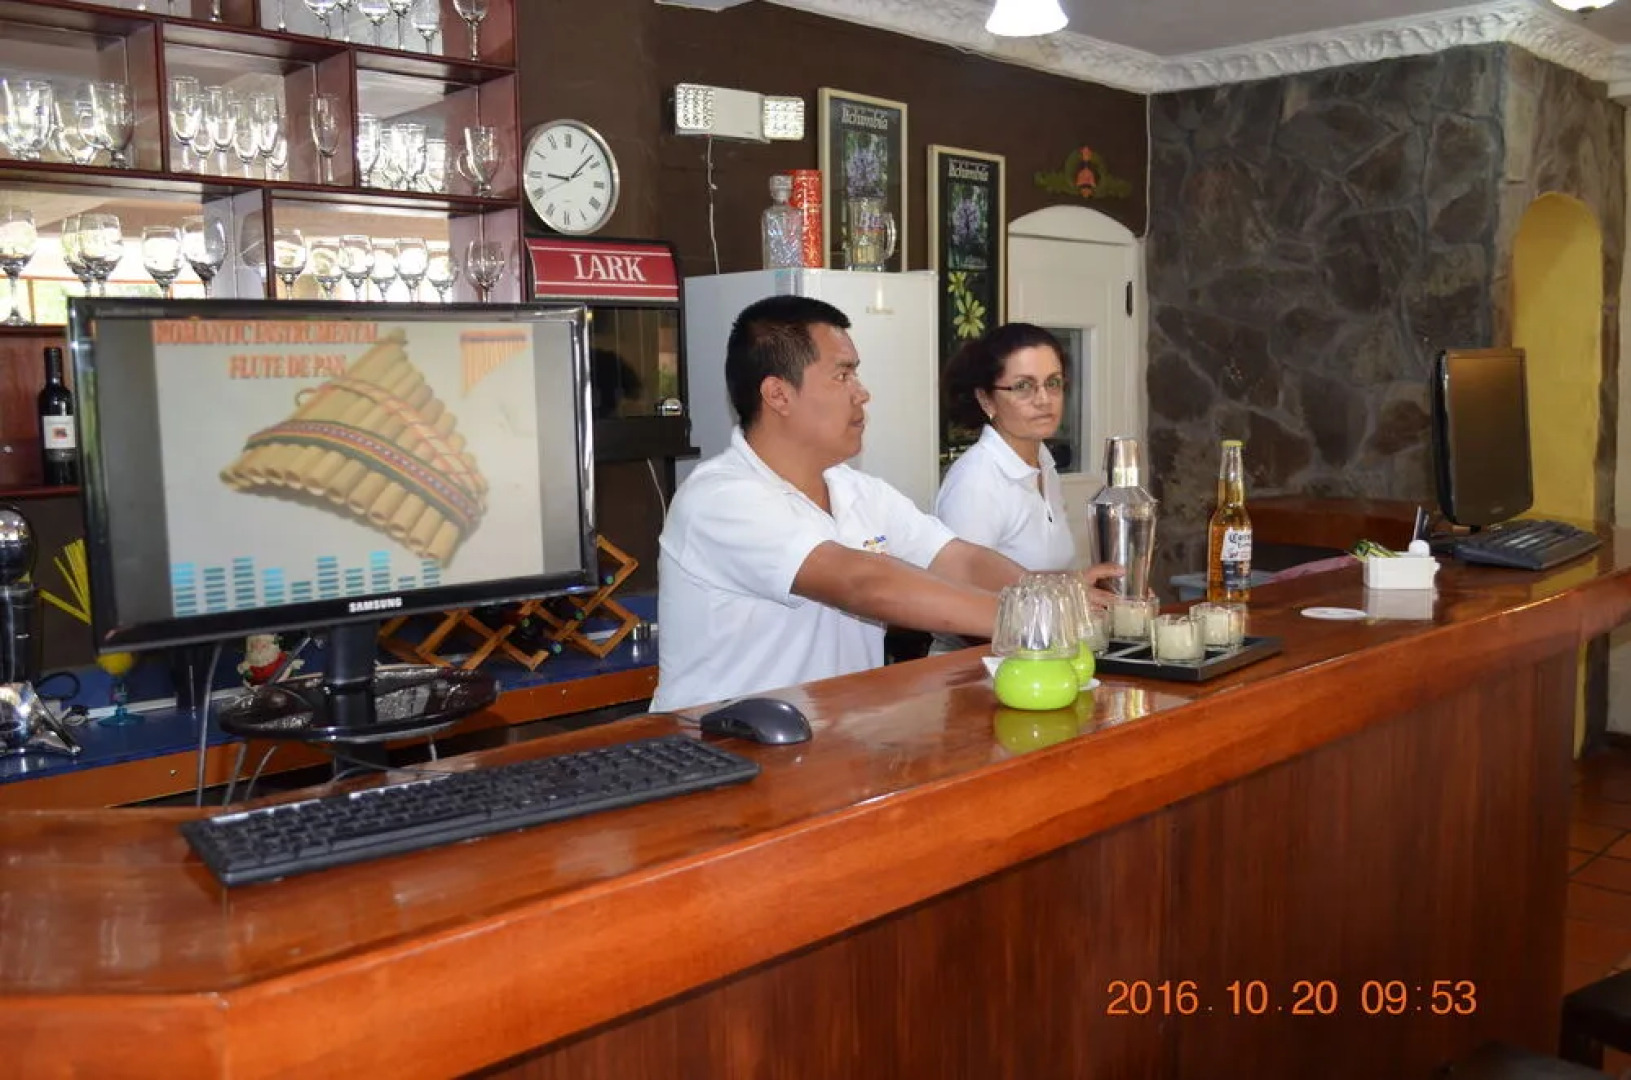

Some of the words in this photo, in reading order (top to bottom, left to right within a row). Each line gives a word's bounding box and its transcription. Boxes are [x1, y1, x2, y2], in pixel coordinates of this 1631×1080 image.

[571, 253, 646, 282] LARK
[228, 353, 282, 379] FLUTE
[285, 353, 311, 378] DE
[348, 596, 403, 613] SAMSUNG
